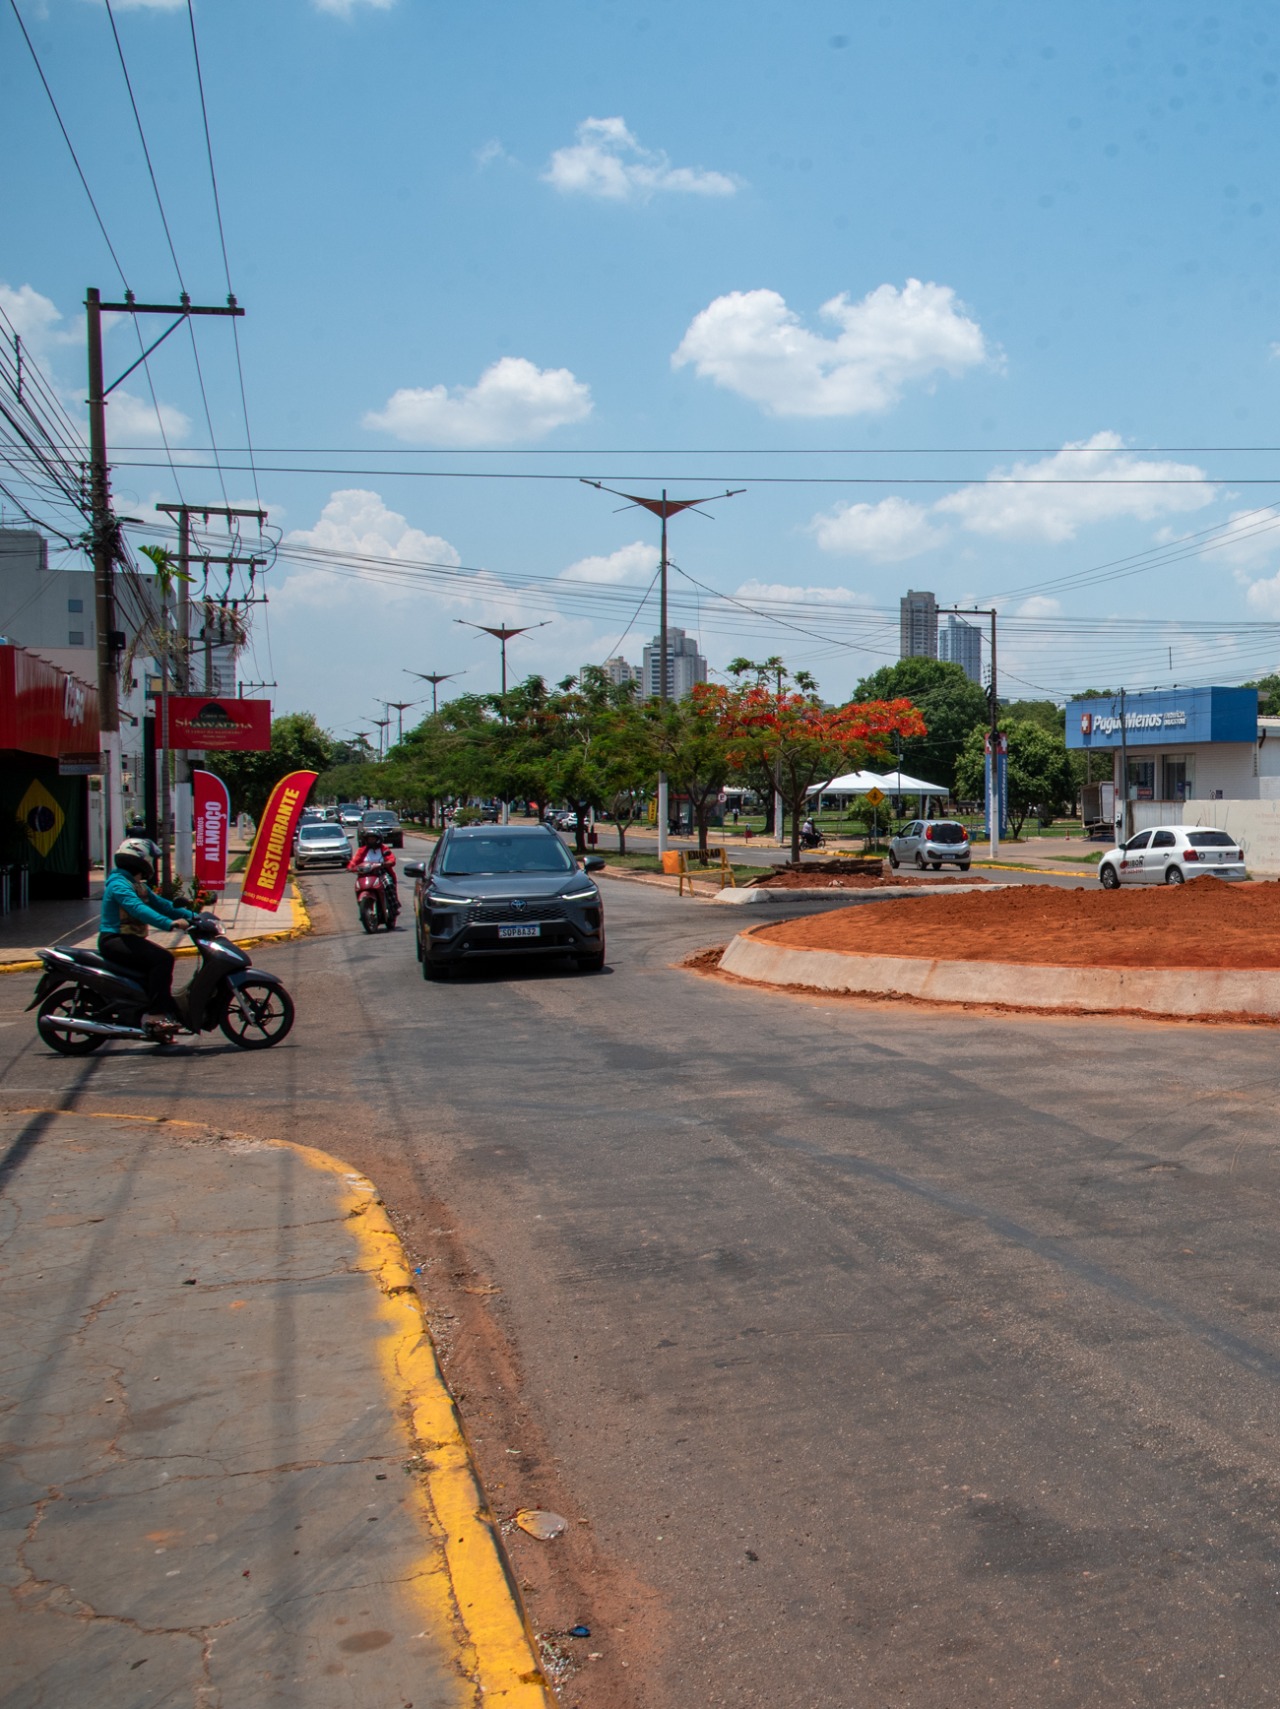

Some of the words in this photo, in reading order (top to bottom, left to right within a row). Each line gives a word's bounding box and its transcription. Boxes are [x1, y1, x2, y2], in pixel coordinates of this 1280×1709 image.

[196, 816, 204, 847] SERVIMOS
[205, 801, 227, 862] ALMOÇO
[256, 787, 300, 890] RESTAURANTE
